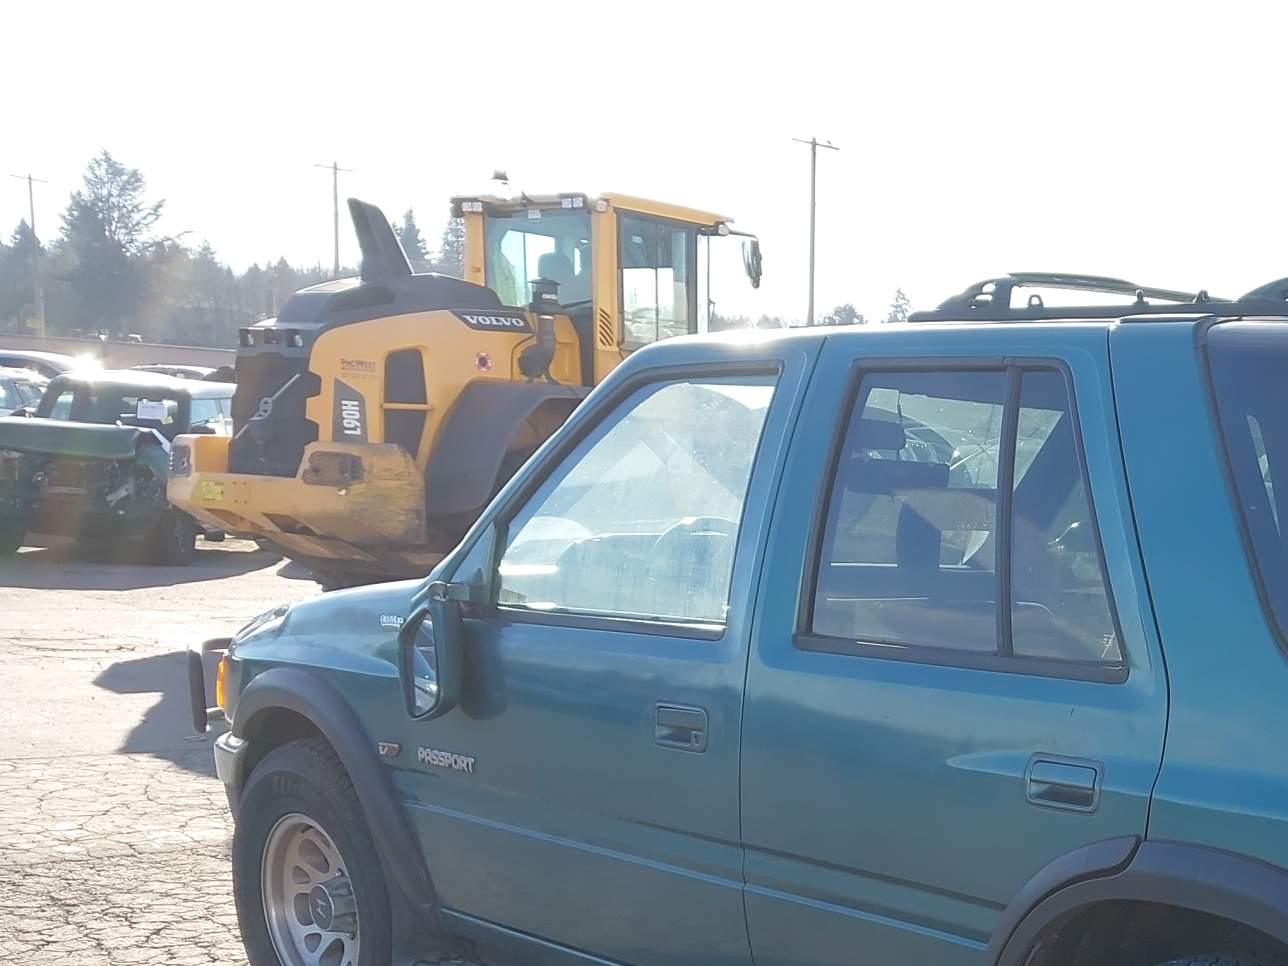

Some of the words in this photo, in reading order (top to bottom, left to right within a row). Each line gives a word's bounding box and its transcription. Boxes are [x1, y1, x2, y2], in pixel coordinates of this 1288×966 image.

[462, 314, 525, 327] VOLVO
[341, 400, 362, 435] L90H
[417, 746, 475, 774] PASSPORT
